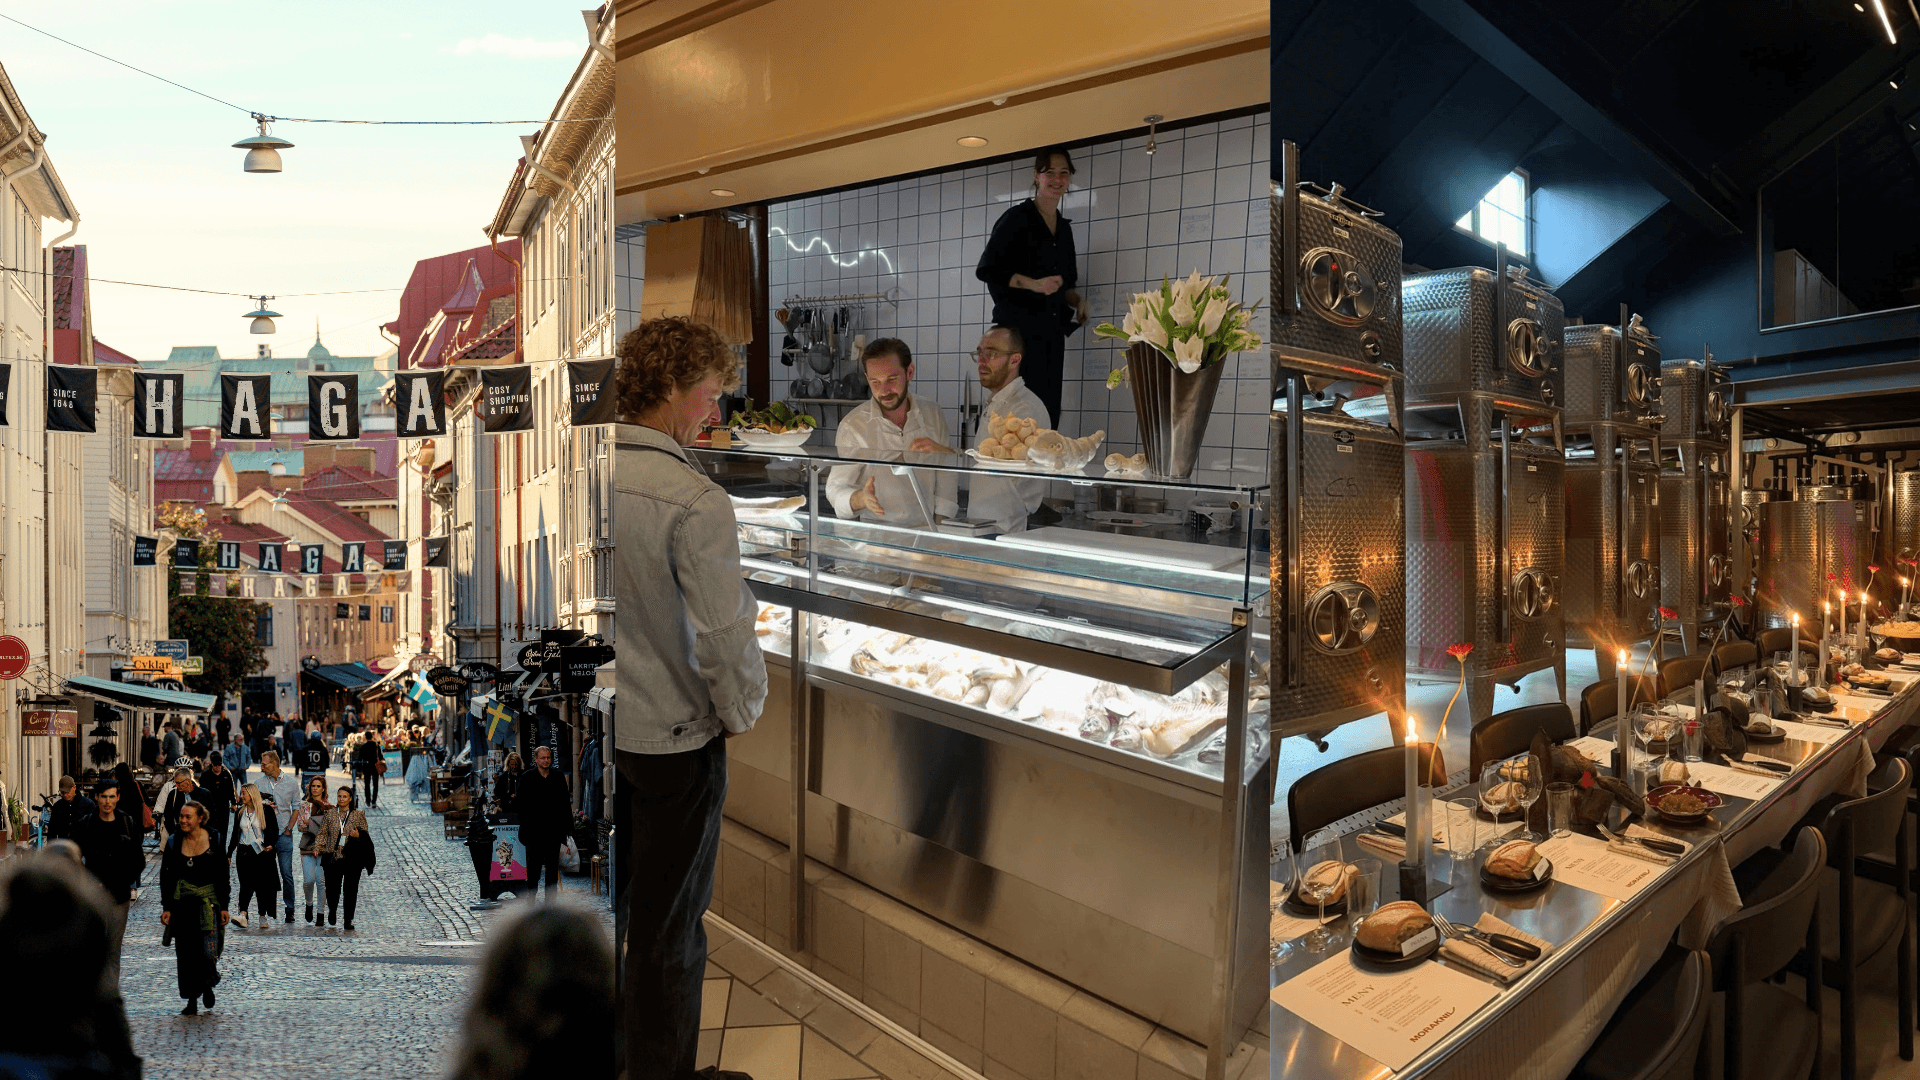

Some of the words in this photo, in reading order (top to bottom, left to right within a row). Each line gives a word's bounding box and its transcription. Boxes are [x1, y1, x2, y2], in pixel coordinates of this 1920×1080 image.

[489, 386, 510, 395] COSY
[575, 382, 600, 393] SINCE
[53, 388, 77, 399] SINCE
[575, 393, 597, 403] 1648
[53, 399, 74, 409] 1648
[489, 394, 529, 406] SHOPPING
[490, 407, 497, 415] &
[500, 406, 520, 415] FIKA
[308, 752, 320, 763] 10
[1341, 984, 1375, 1007] MENY
